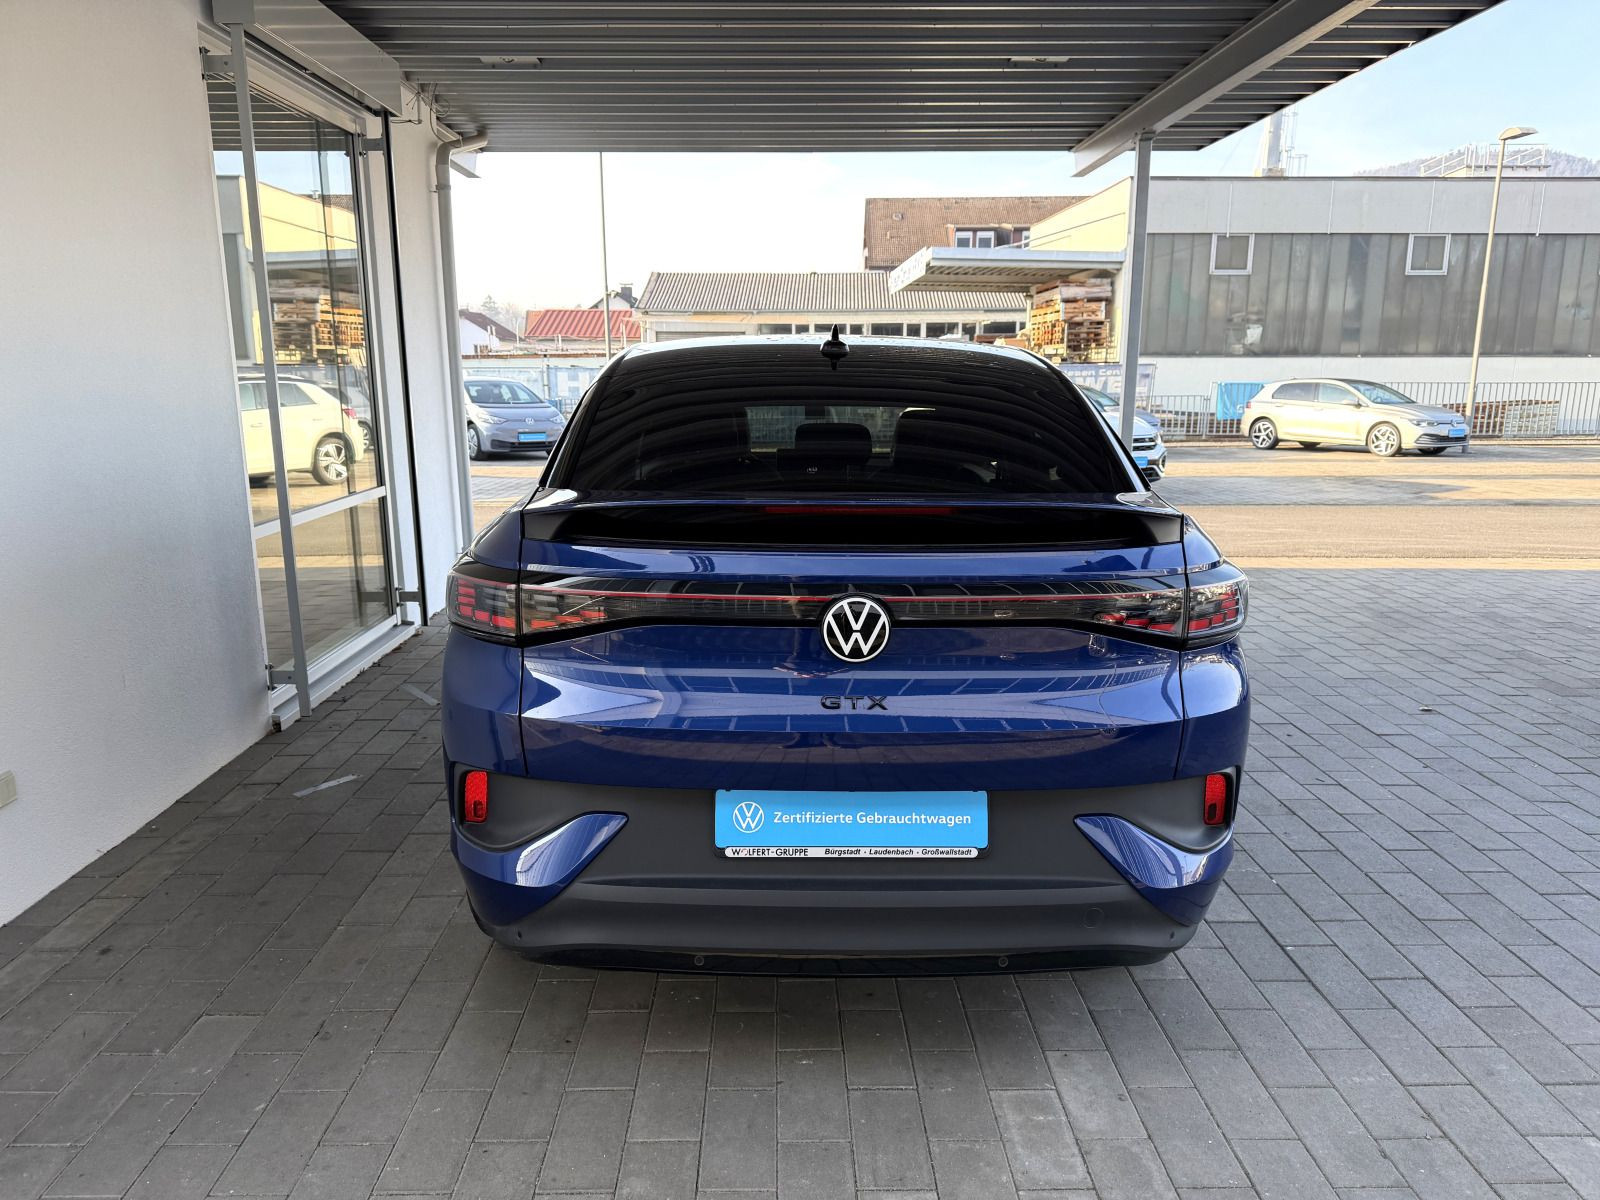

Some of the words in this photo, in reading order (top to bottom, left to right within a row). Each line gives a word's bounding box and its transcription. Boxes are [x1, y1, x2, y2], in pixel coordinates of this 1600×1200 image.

[1098, 368, 1123, 376] Cen
[820, 694, 889, 711] GTX
[773, 811, 853, 824] Zertifizierte
[856, 811, 972, 827] Gebrauchtwagen
[921, 848, 972, 856] Großwallstadt
